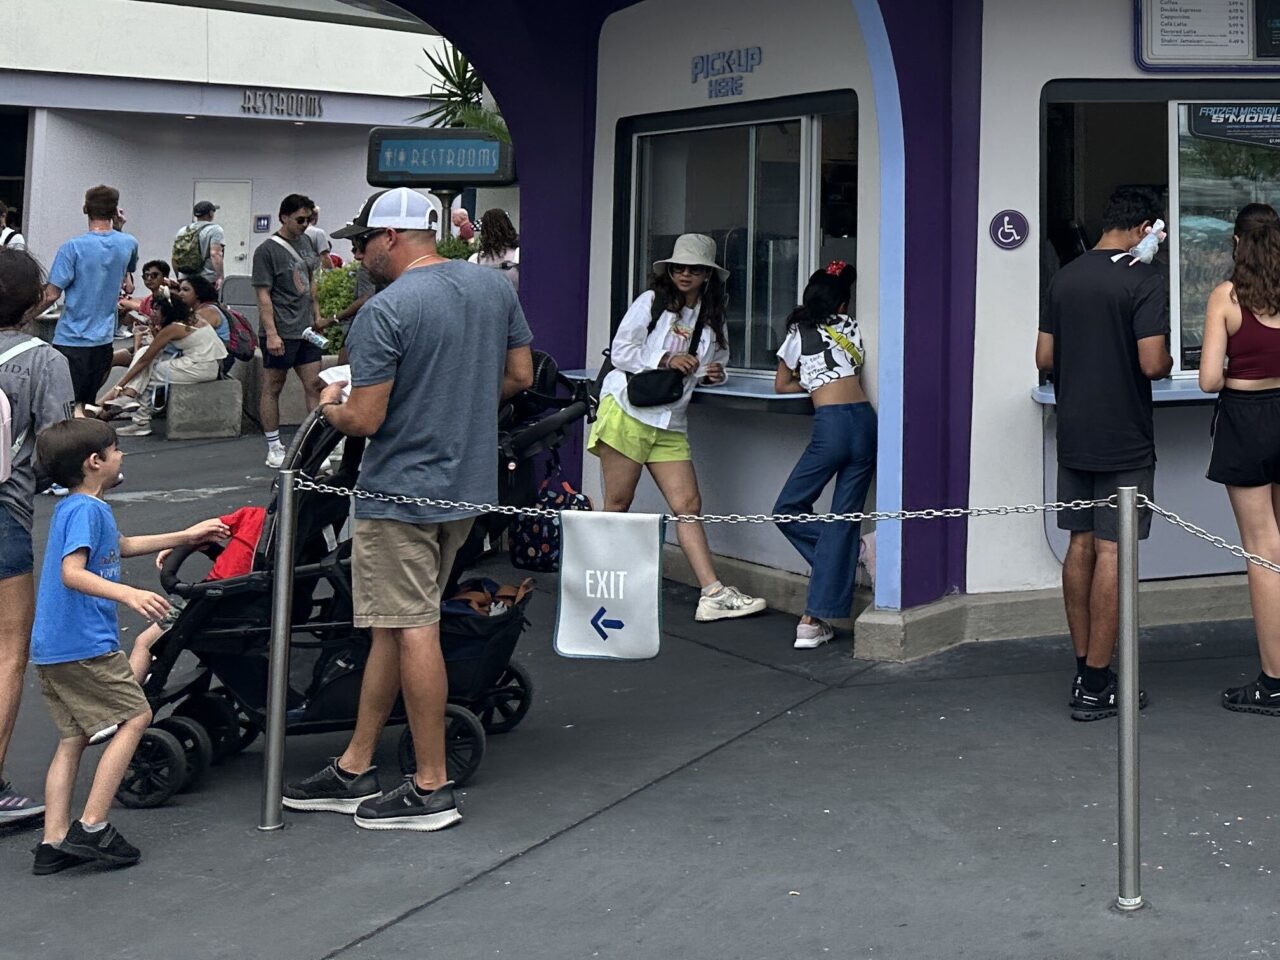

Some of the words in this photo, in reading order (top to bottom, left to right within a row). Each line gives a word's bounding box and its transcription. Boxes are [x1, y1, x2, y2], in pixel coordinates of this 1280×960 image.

[707, 75, 744, 99] HERE
[240, 88, 325, 118] RESTROOMS
[1200, 107, 1240, 117] FROZEN
[1240, 107, 1279, 116] MISSION
[410, 147, 498, 167] RESTROOMS
[585, 569, 628, 600] EXIT
